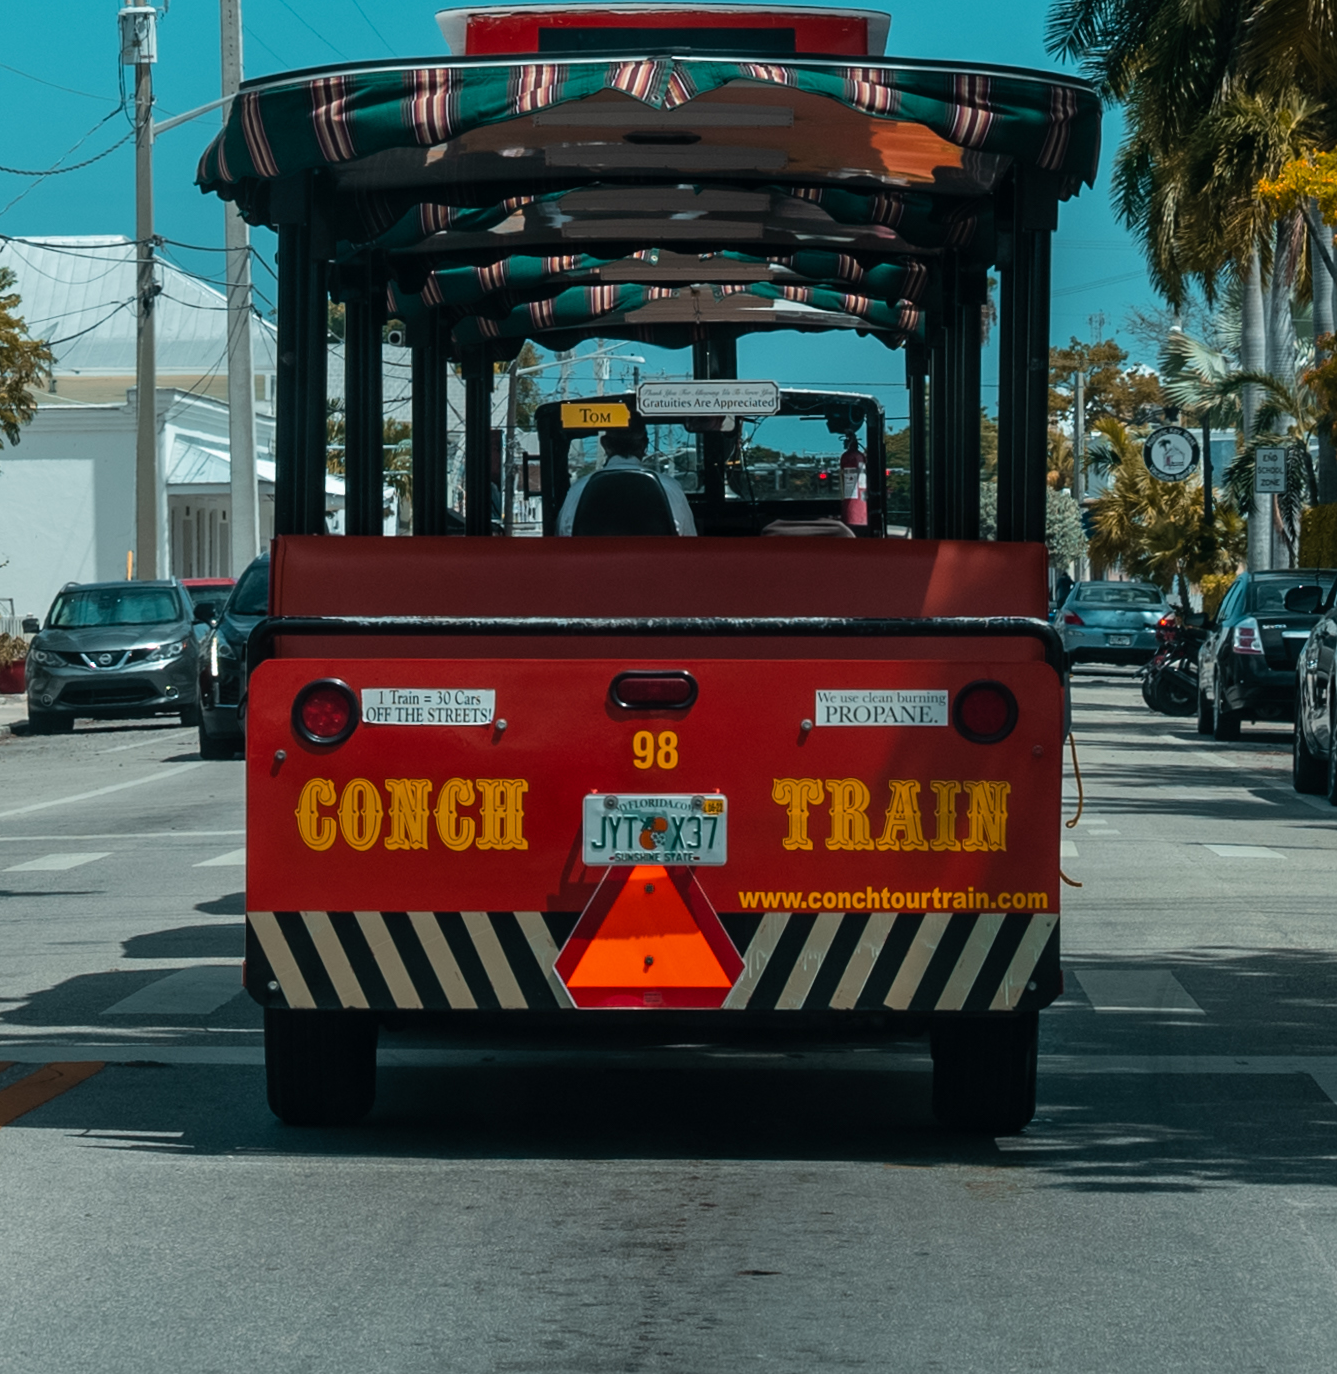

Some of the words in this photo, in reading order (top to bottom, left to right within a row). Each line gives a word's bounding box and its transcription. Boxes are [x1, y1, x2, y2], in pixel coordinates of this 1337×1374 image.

[642, 398, 691, 408] Gratuities
[694, 398, 710, 408] Are
[713, 398, 775, 410] Appreciated
[1263, 454, 1278, 462] END
[1257, 466, 1284, 474] SCHOOL
[1260, 478, 1280, 486] ZONE
[379, 691, 384, 704] 1
[389, 690, 419, 705] Train
[436, 691, 451, 705] 30
[454, 690, 481, 705] Cars
[817, 692, 837, 703] We
[840, 695, 859, 703] use
[862, 692, 893, 703] clean
[896, 692, 947, 706] burning
[366, 707, 392, 722] OFF
[395, 707, 423, 722] THE
[427, 708, 492, 723] STREETS!
[825, 706, 938, 724] PROPANE.
[632, 730, 680, 770] 98
[294, 777, 530, 852] CONCH
[772, 778, 1009, 852] TRAIN
[591, 815, 639, 849] JYT
[671, 815, 718, 849] X37
[614, 852, 661, 862] SUNSHINE
[663, 852, 694, 862] STATE
[738, 887, 1048, 910] www.conchtourtrain.com
